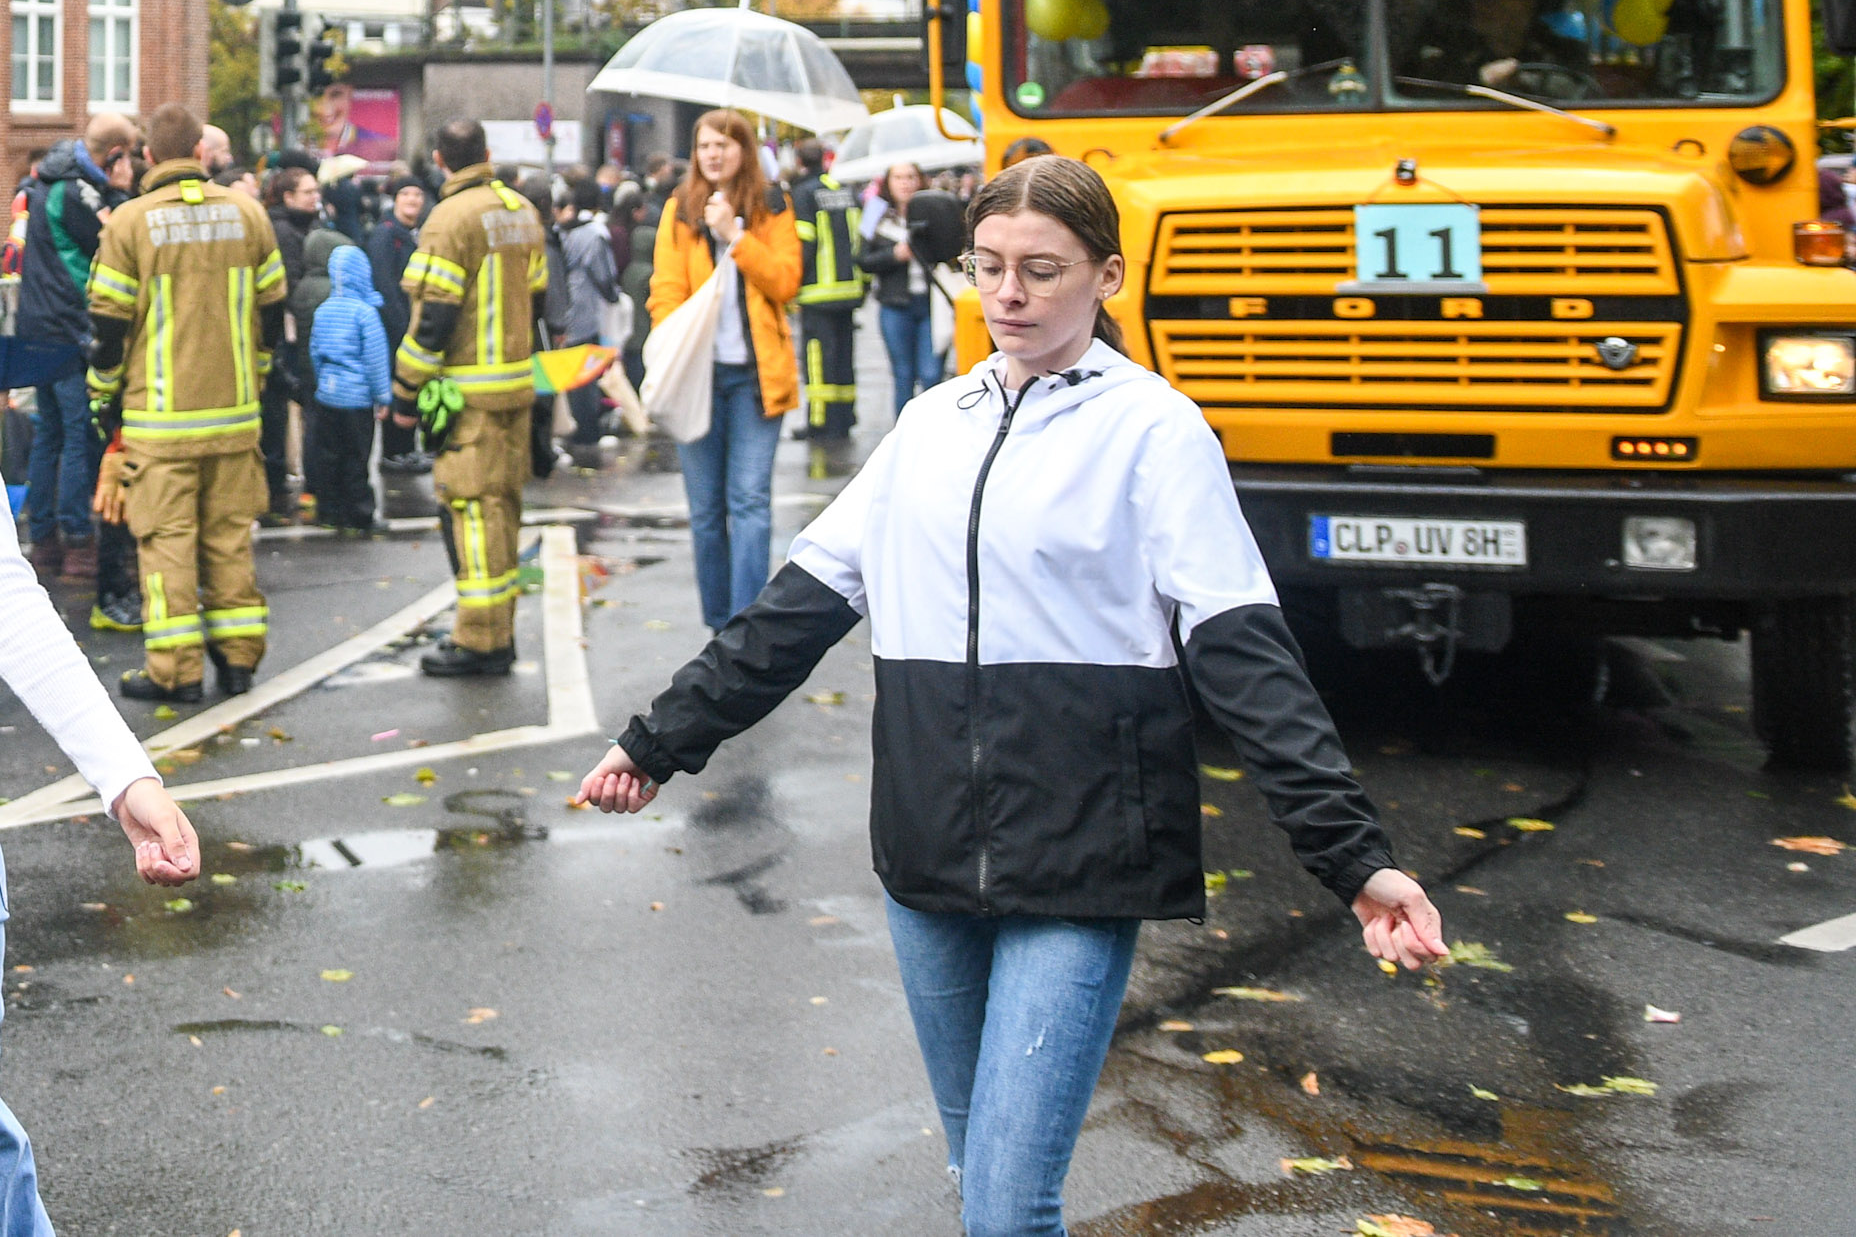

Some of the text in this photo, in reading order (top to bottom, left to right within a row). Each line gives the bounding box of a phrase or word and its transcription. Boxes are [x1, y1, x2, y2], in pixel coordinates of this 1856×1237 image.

[1373, 226, 1464, 280] 11
[1228, 296, 1595, 320] FORD
[1335, 523, 1393, 553] CLP
[1413, 525, 1453, 555] UV
